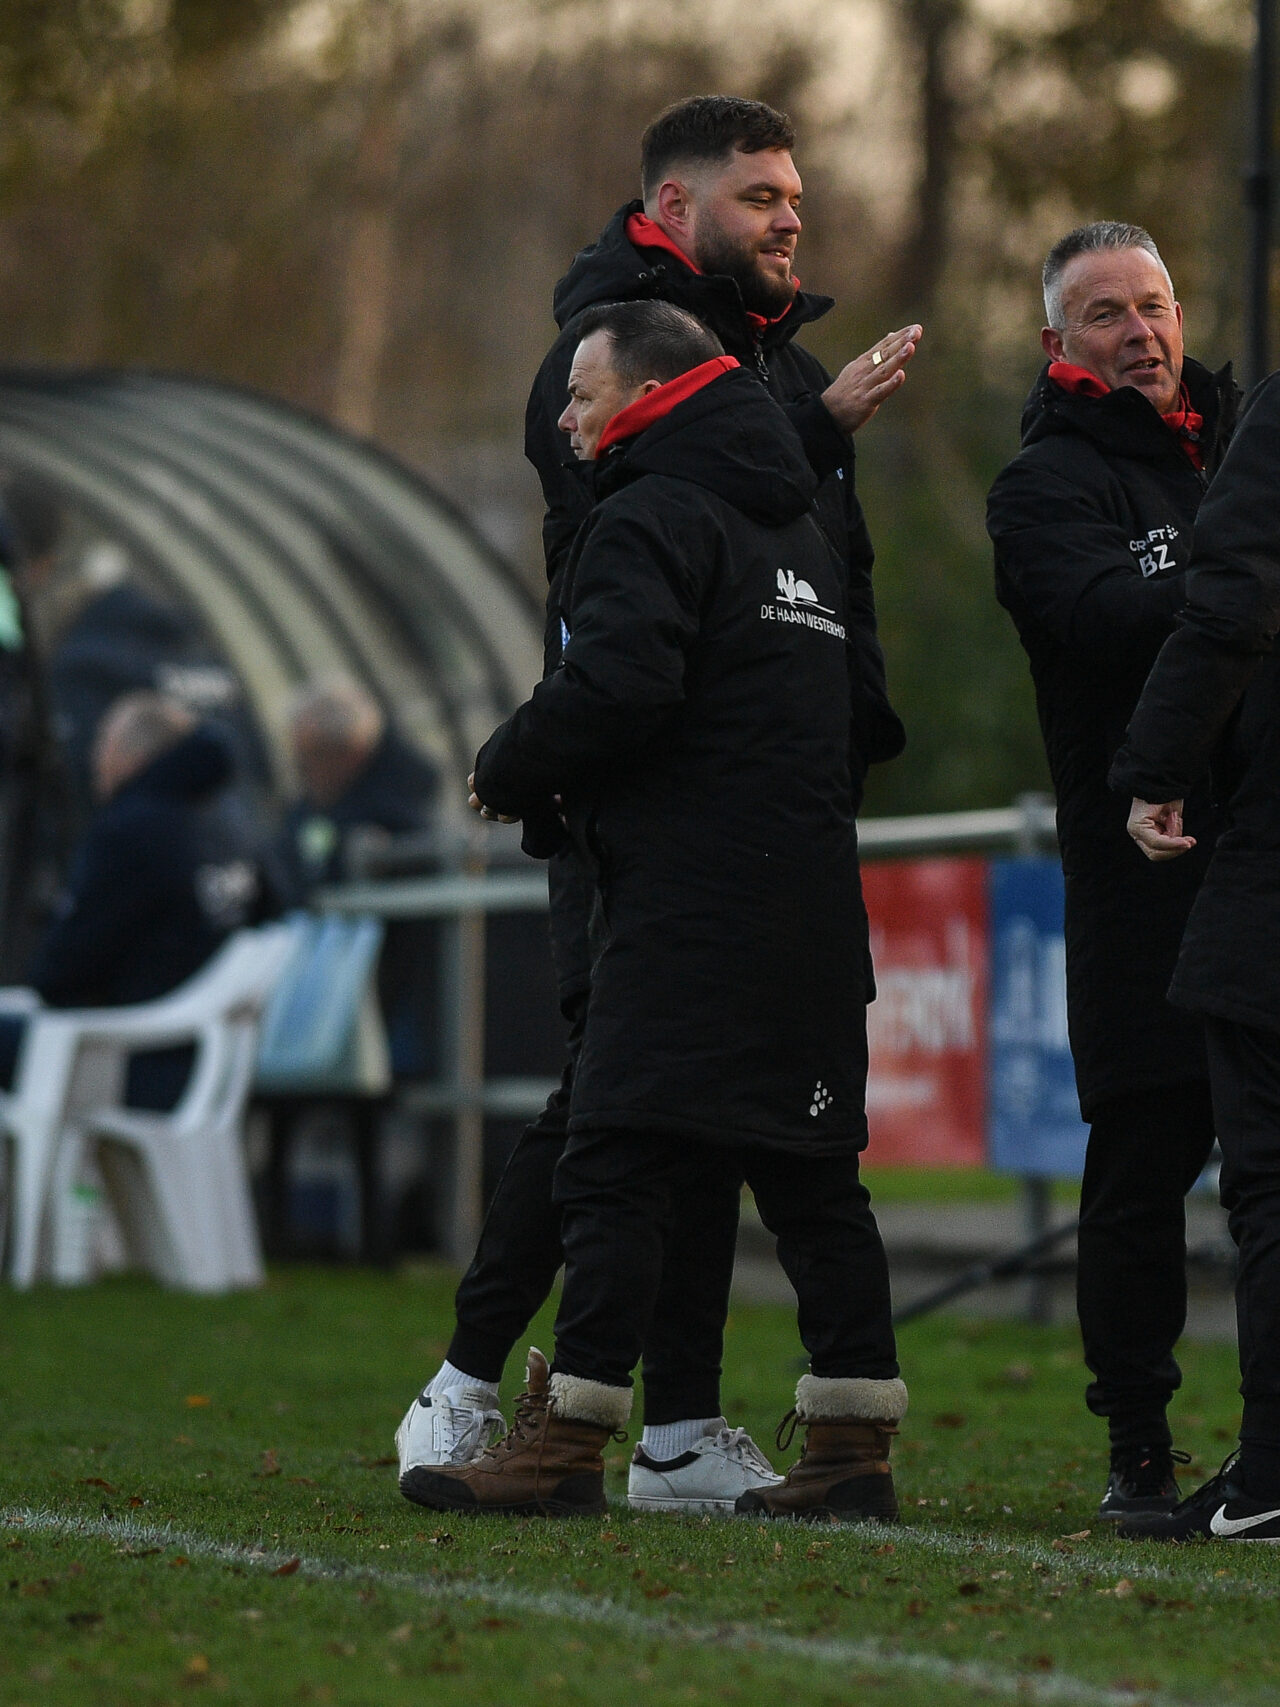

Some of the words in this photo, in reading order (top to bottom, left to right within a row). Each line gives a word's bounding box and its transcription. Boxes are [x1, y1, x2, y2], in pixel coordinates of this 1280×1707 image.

[1129, 528, 1166, 552] CRFT
[1139, 544, 1177, 578] BZ
[760, 604, 776, 620] DE
[776, 607, 807, 625] HAAN
